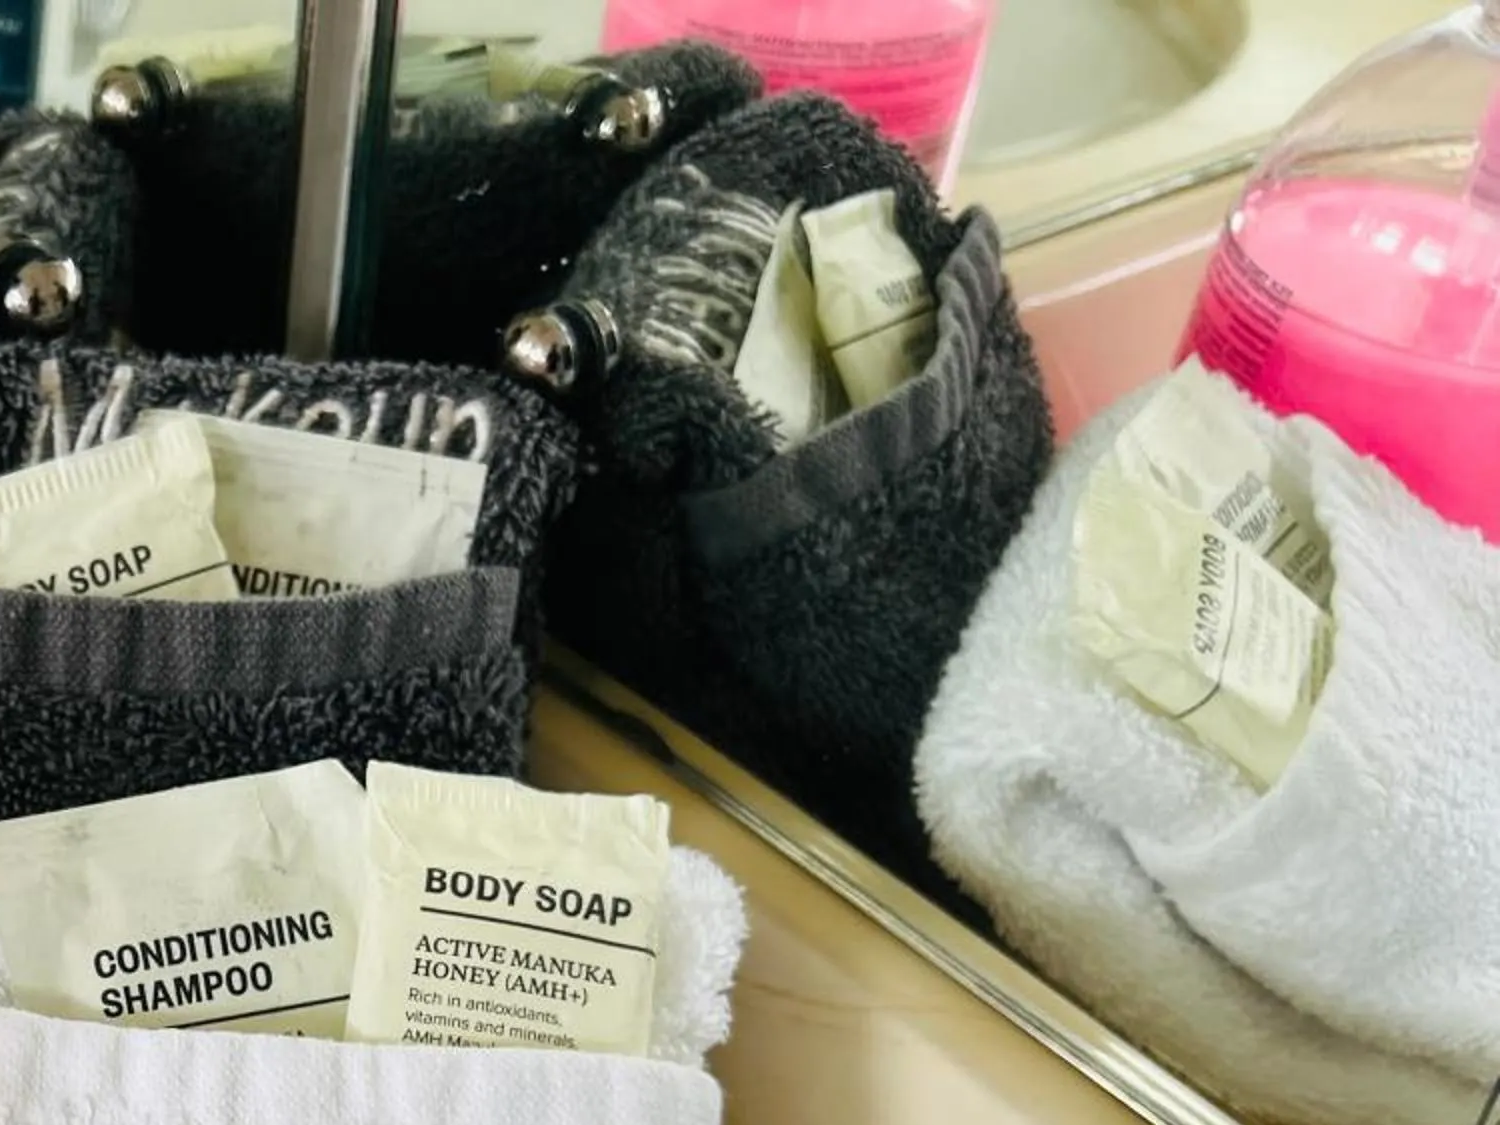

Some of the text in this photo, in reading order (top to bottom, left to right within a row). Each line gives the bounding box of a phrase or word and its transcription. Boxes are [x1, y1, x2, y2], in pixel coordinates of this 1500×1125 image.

[68, 545, 152, 595] SOAP
[425, 867, 633, 926] BODY SOAP
[93, 910, 333, 978] CONDITIONING
[414, 934, 618, 987] ACTIVE MANUKA
[101, 961, 273, 1018] SHAMPOO
[408, 987, 443, 1006] Rich
[449, 993, 461, 1008] in
[411, 957, 589, 1007] HONEY (AMH+)
[402, 1028, 443, 1048] AMH
[405, 1009, 470, 1031] vitamins
[474, 1019, 505, 1038] and
